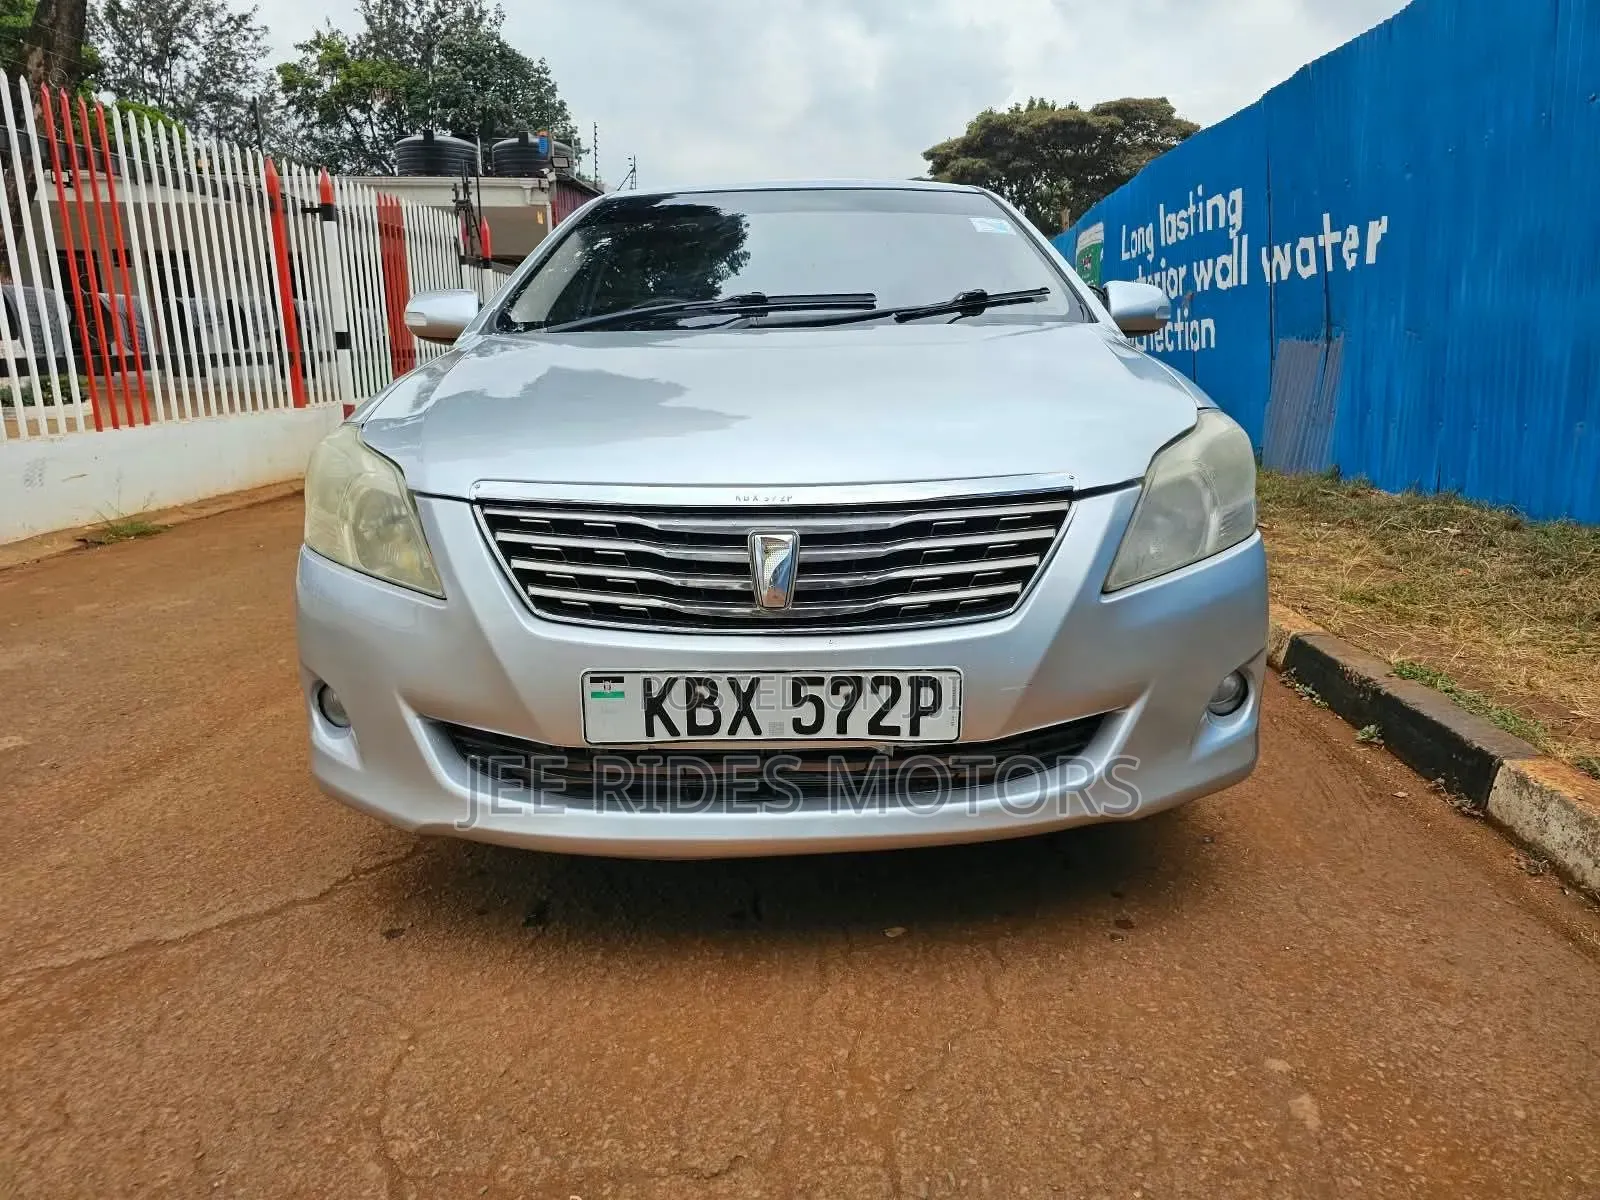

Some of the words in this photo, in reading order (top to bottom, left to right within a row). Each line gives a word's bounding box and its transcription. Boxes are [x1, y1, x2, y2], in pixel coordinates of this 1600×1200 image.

[1120, 222, 1155, 262] Long
[1159, 184, 1244, 247] lasting
[1134, 256, 1187, 300] trior
[1193, 234, 1249, 293] wall
[1261, 212, 1388, 286] water
[1128, 307, 1216, 353] ection
[642, 676, 763, 738] KBX
[791, 675, 943, 737] 572P
